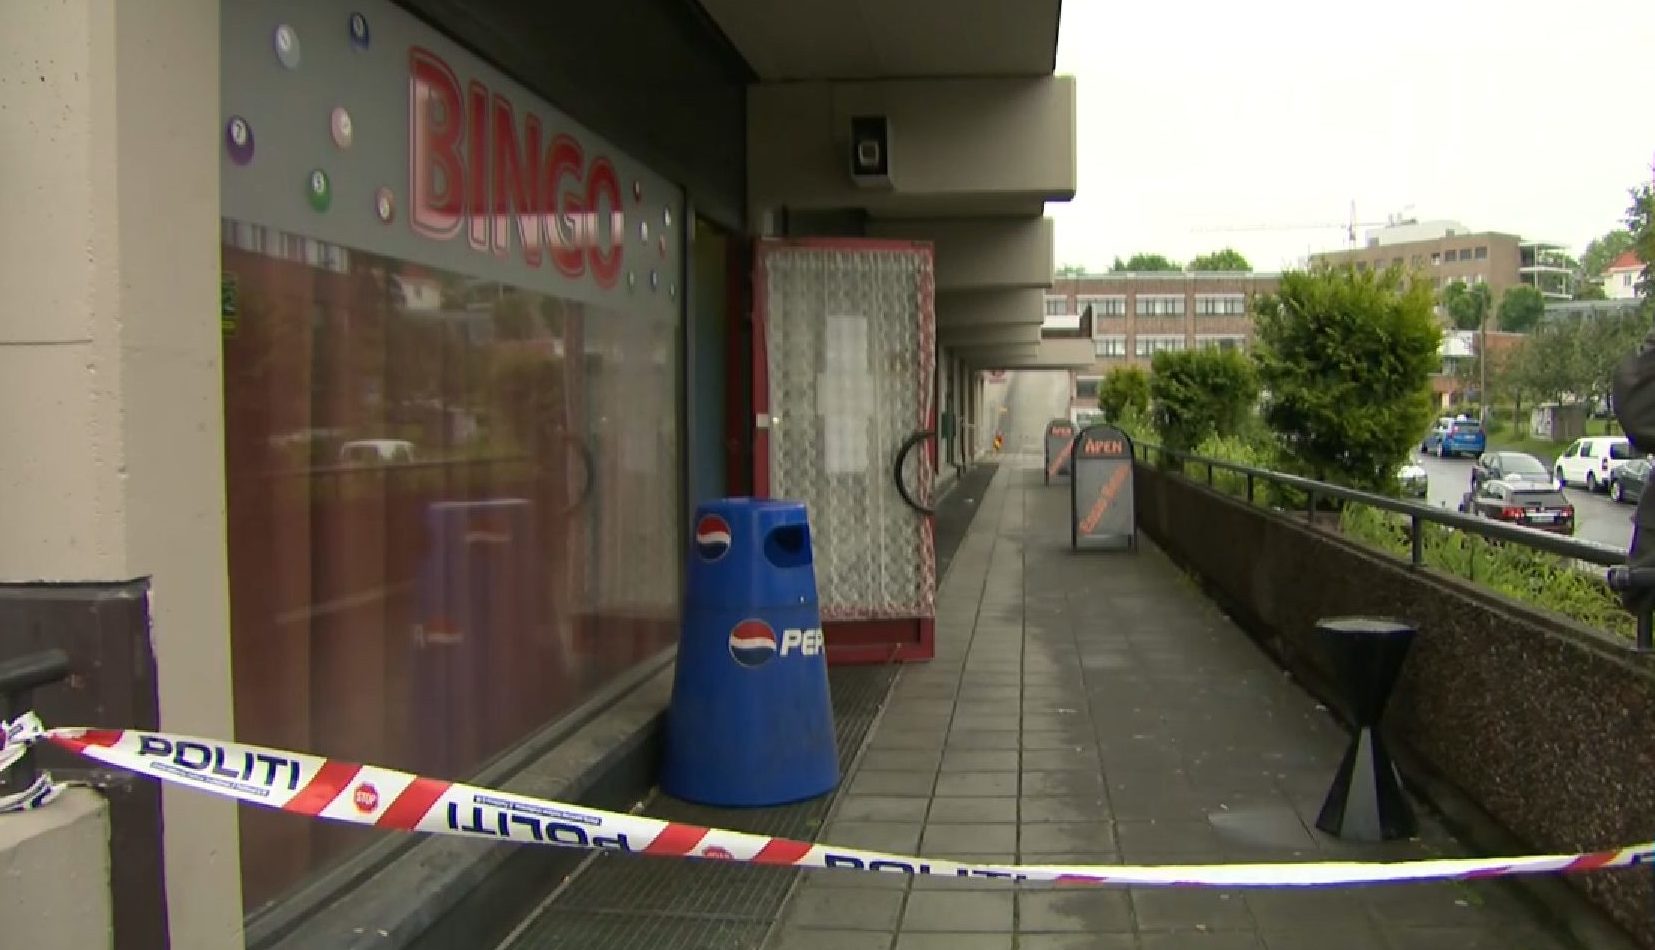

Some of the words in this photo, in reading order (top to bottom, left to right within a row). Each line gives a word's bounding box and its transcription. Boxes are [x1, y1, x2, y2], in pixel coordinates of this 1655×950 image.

[407, 45, 625, 291] BINGO
[137, 735, 301, 790] POLITI
[356, 791, 377, 805] STOP
[446, 801, 631, 853] POLITI
